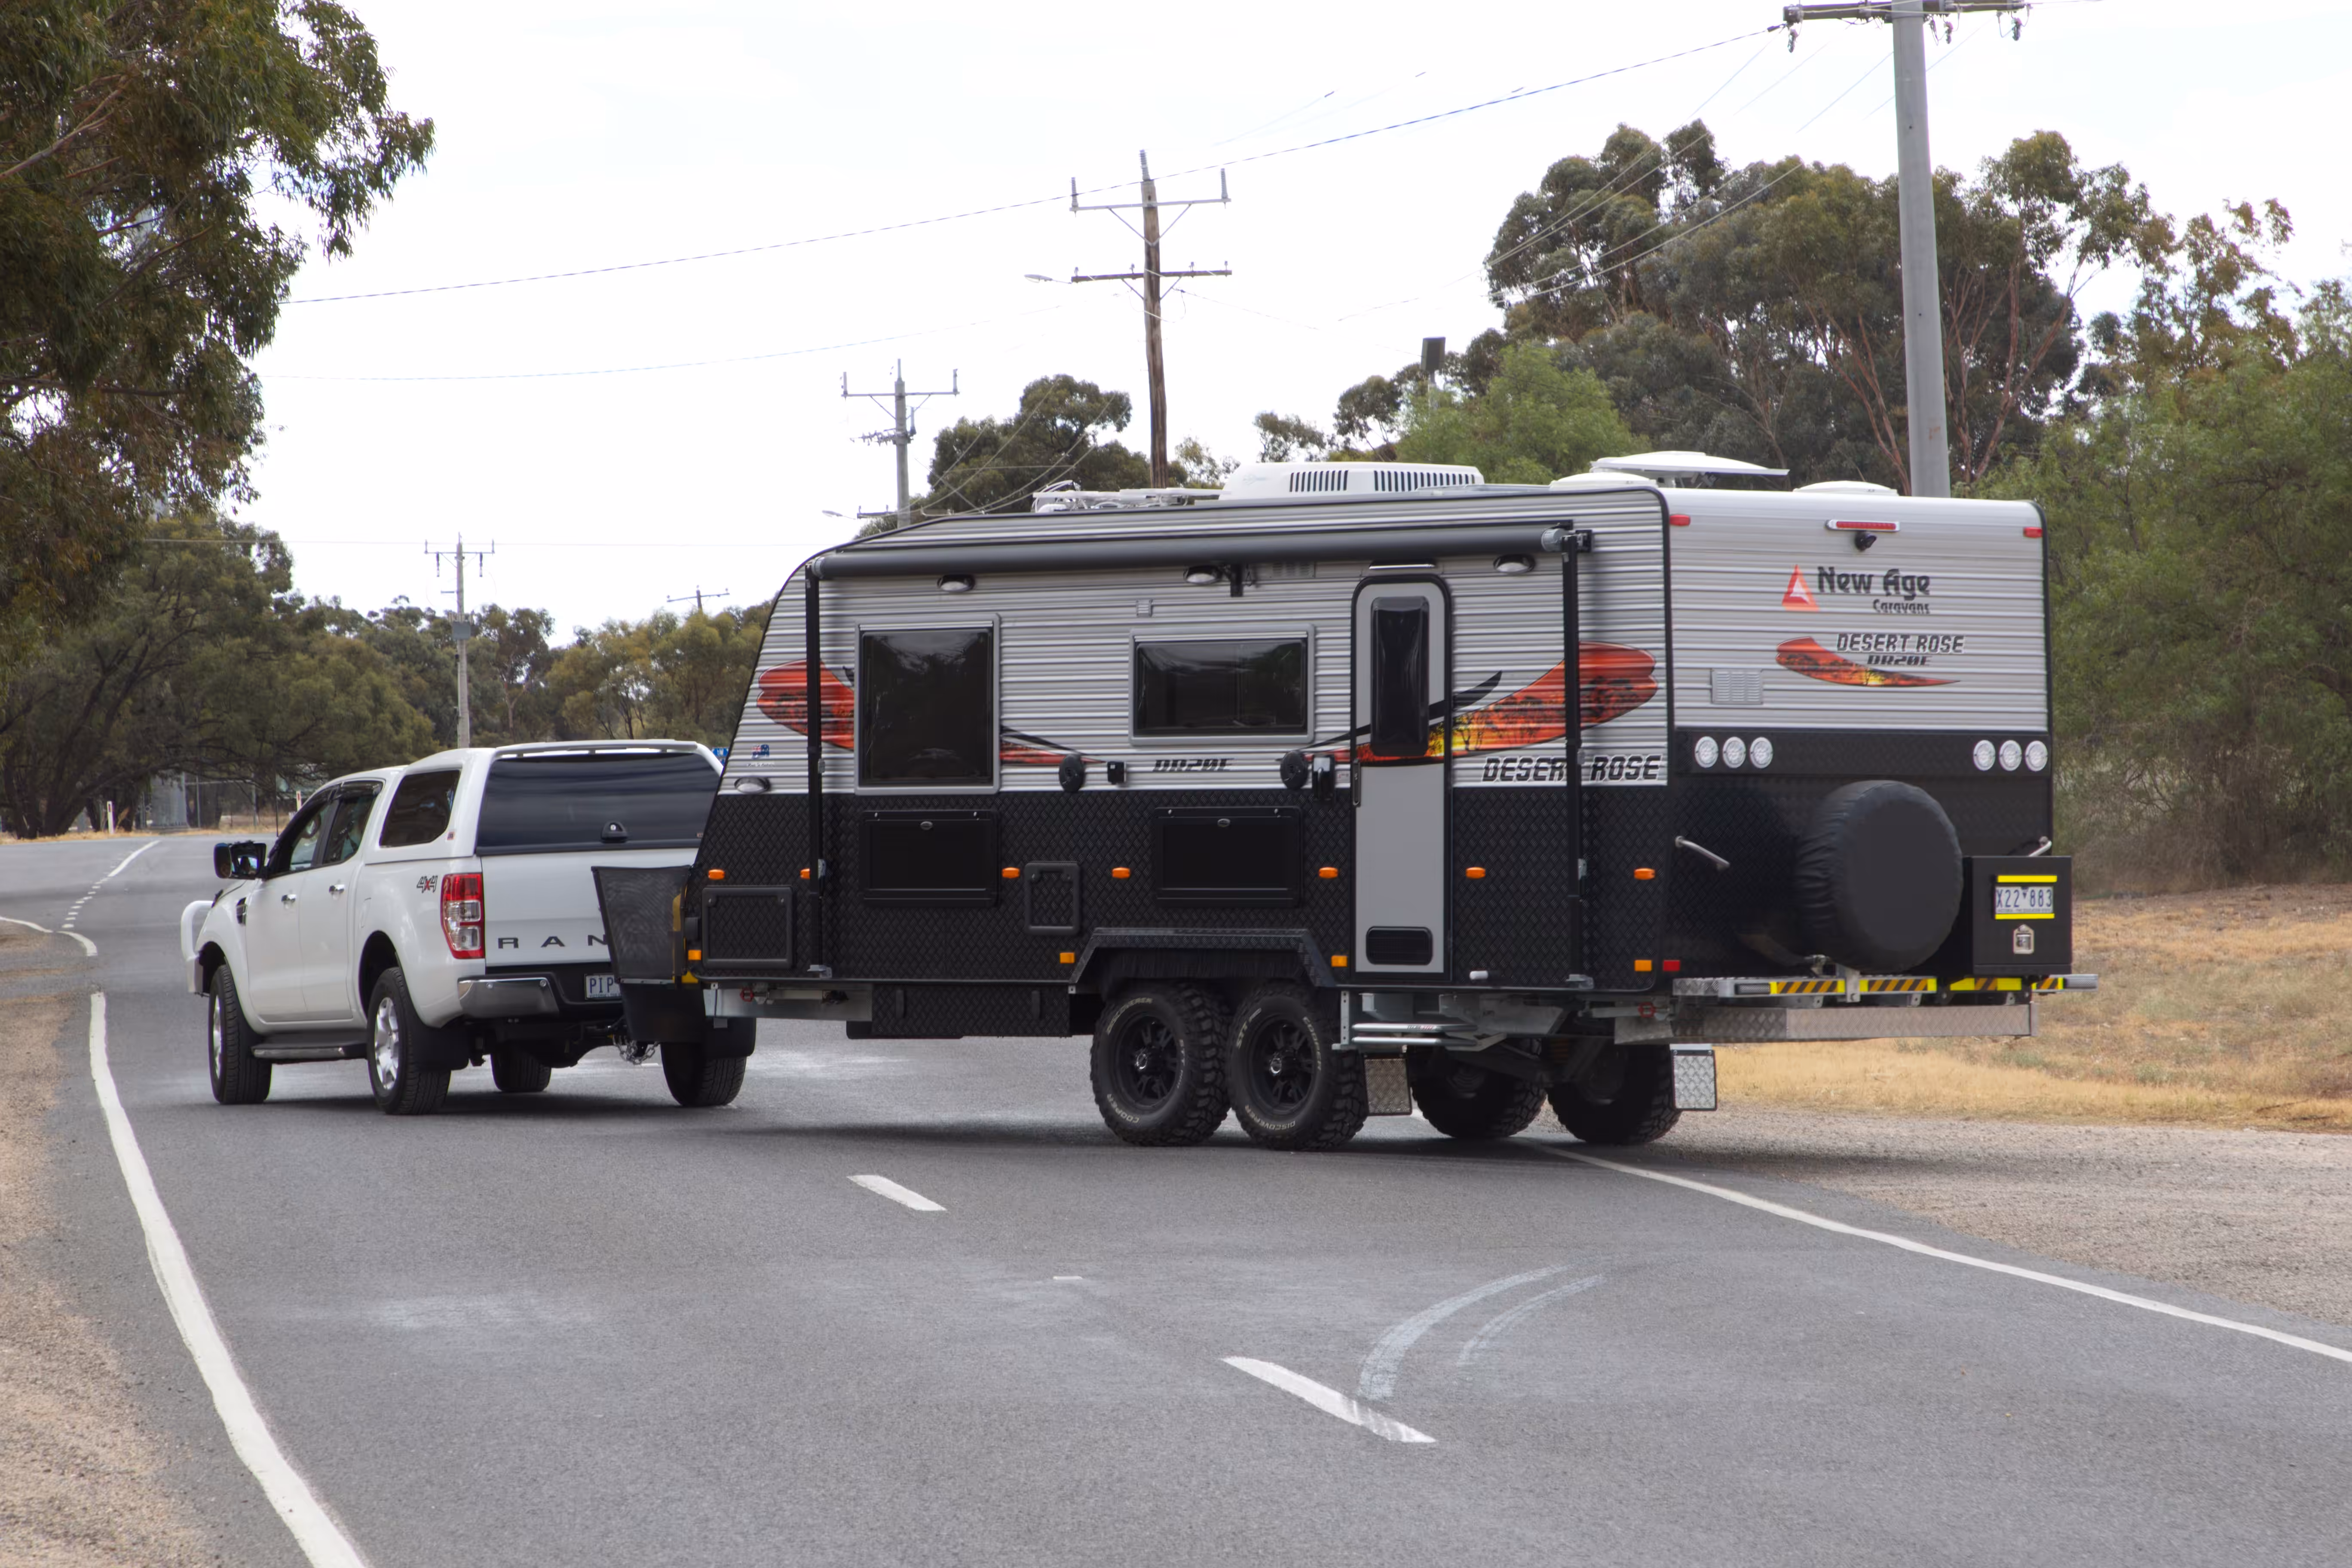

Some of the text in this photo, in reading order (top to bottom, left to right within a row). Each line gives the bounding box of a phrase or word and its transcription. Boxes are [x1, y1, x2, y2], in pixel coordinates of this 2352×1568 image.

[1817, 566, 1930, 601] New Age
[1873, 599, 1931, 615] Caravans
[1836, 633, 1965, 654] DESERT ROSE
[1482, 755, 1662, 782] DESER ROSE
[1996, 889, 2052, 908] X22 883
[498, 934, 608, 949] RAN
[589, 976, 614, 994] PIP
[1302, 1016, 1322, 1072] COOPER
[1106, 1093, 1140, 1124] COOPER
[1245, 1104, 1296, 1131] DISCOVERER
